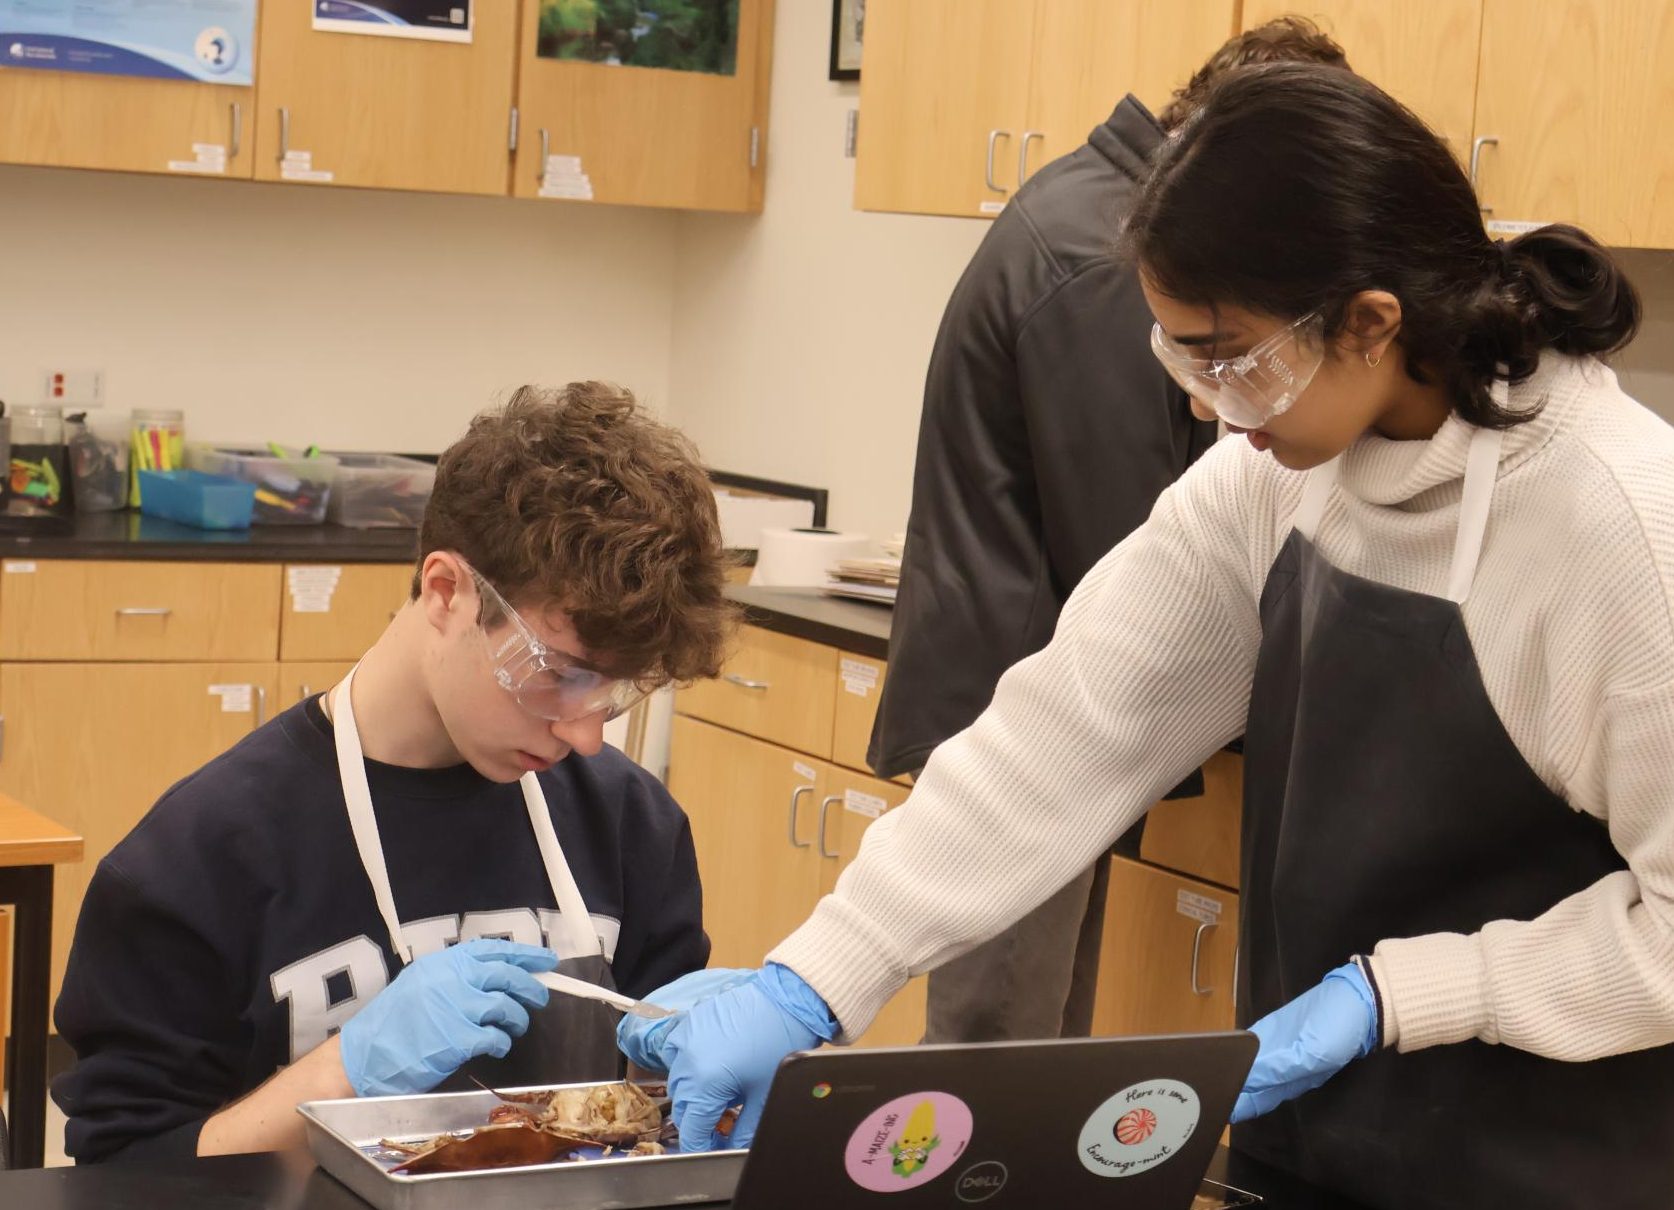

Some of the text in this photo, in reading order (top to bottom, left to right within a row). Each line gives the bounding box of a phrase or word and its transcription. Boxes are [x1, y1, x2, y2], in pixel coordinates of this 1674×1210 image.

[1125, 1089, 1153, 1103] Here
[1168, 1089, 1188, 1104] some
[861, 1113, 899, 1165] A-MAIZE-ING
[1087, 1143, 1171, 1174] Encourage-mint
[962, 1176, 1000, 1188] DELL
